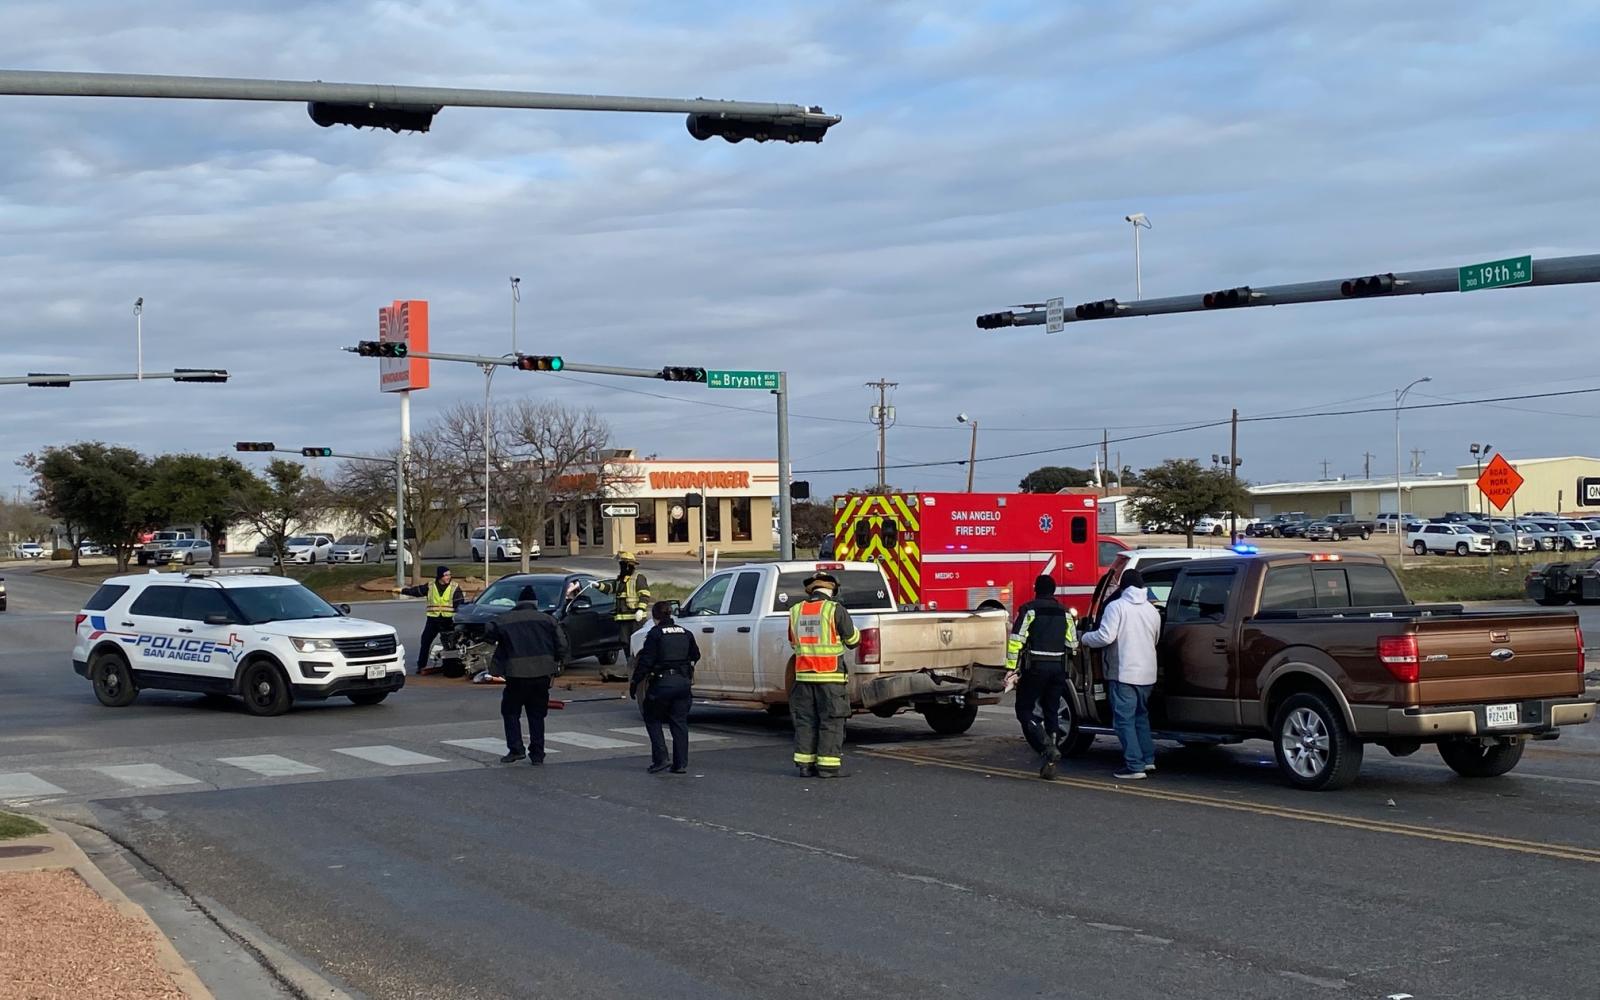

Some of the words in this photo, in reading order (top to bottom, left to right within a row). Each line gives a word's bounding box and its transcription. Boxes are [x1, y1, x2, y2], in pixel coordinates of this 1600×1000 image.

[1480, 265, 1510, 284] 19th
[1513, 271, 1525, 279] 500
[723, 373, 762, 387] Bryant
[1489, 468, 1507, 476] ROAD
[1489, 487, 1511, 495] AHEAD
[951, 511, 968, 521] SAN
[969, 511, 1001, 521] ANGELO
[955, 526, 973, 536] FIRE
[975, 526, 997, 536] DEPT.
[136, 635, 216, 654] POLICE
[143, 648, 165, 658] SAN
[167, 650, 211, 663] ANGELO
